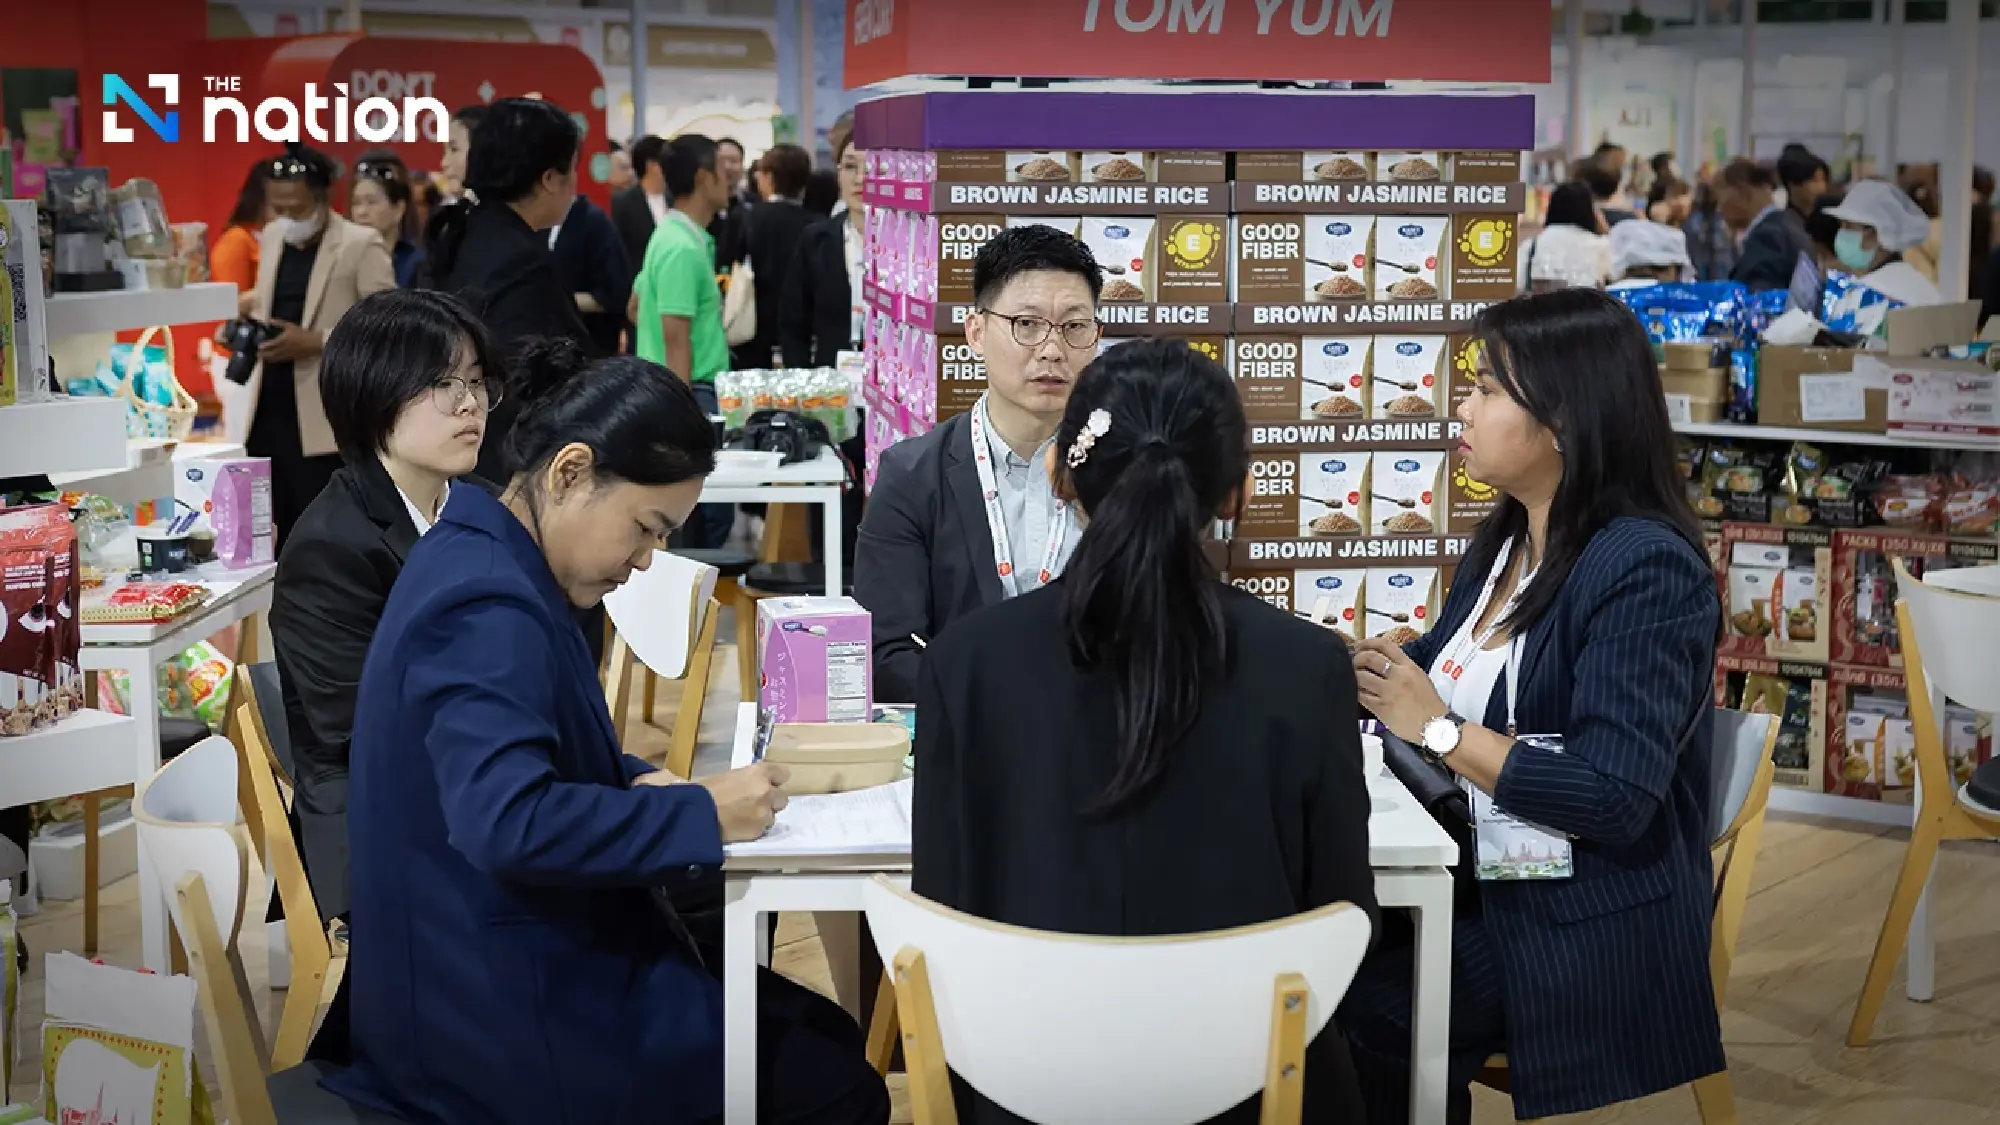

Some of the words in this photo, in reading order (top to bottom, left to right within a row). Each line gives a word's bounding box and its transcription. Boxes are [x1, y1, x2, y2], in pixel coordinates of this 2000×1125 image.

[1255, 0, 1395, 38] YUM
[951, 185, 1038, 204] BROWN
[1045, 185, 1149, 204] JASMINE
[1154, 185, 1209, 204] RICE
[1256, 184, 1340, 203] BROWN
[1347, 184, 1447, 204] JASMINE
[1453, 185, 1507, 204] RICE
[1241, 223, 1300, 241] GOOD
[1479, 231, 1493, 249] E
[1242, 242, 1299, 260] FIBER
[1095, 305, 1149, 323] MINE
[1154, 305, 1209, 324] RICE
[1253, 306, 1337, 324] BROWN
[1344, 304, 1444, 323] JASMINE
[1238, 342, 1298, 360] GOOD
[942, 362, 987, 380] FIBE
[1239, 361, 1296, 378] FIBER
[1252, 425, 1336, 444] BROWN
[1342, 422, 1441, 442] JASMINE
[1248, 460, 1296, 477] OOD
[1252, 479, 1295, 496] BER
[1249, 541, 1332, 560] BROWN
[1338, 539, 1438, 558] JASMINE
[1444, 538, 1474, 556] RI
